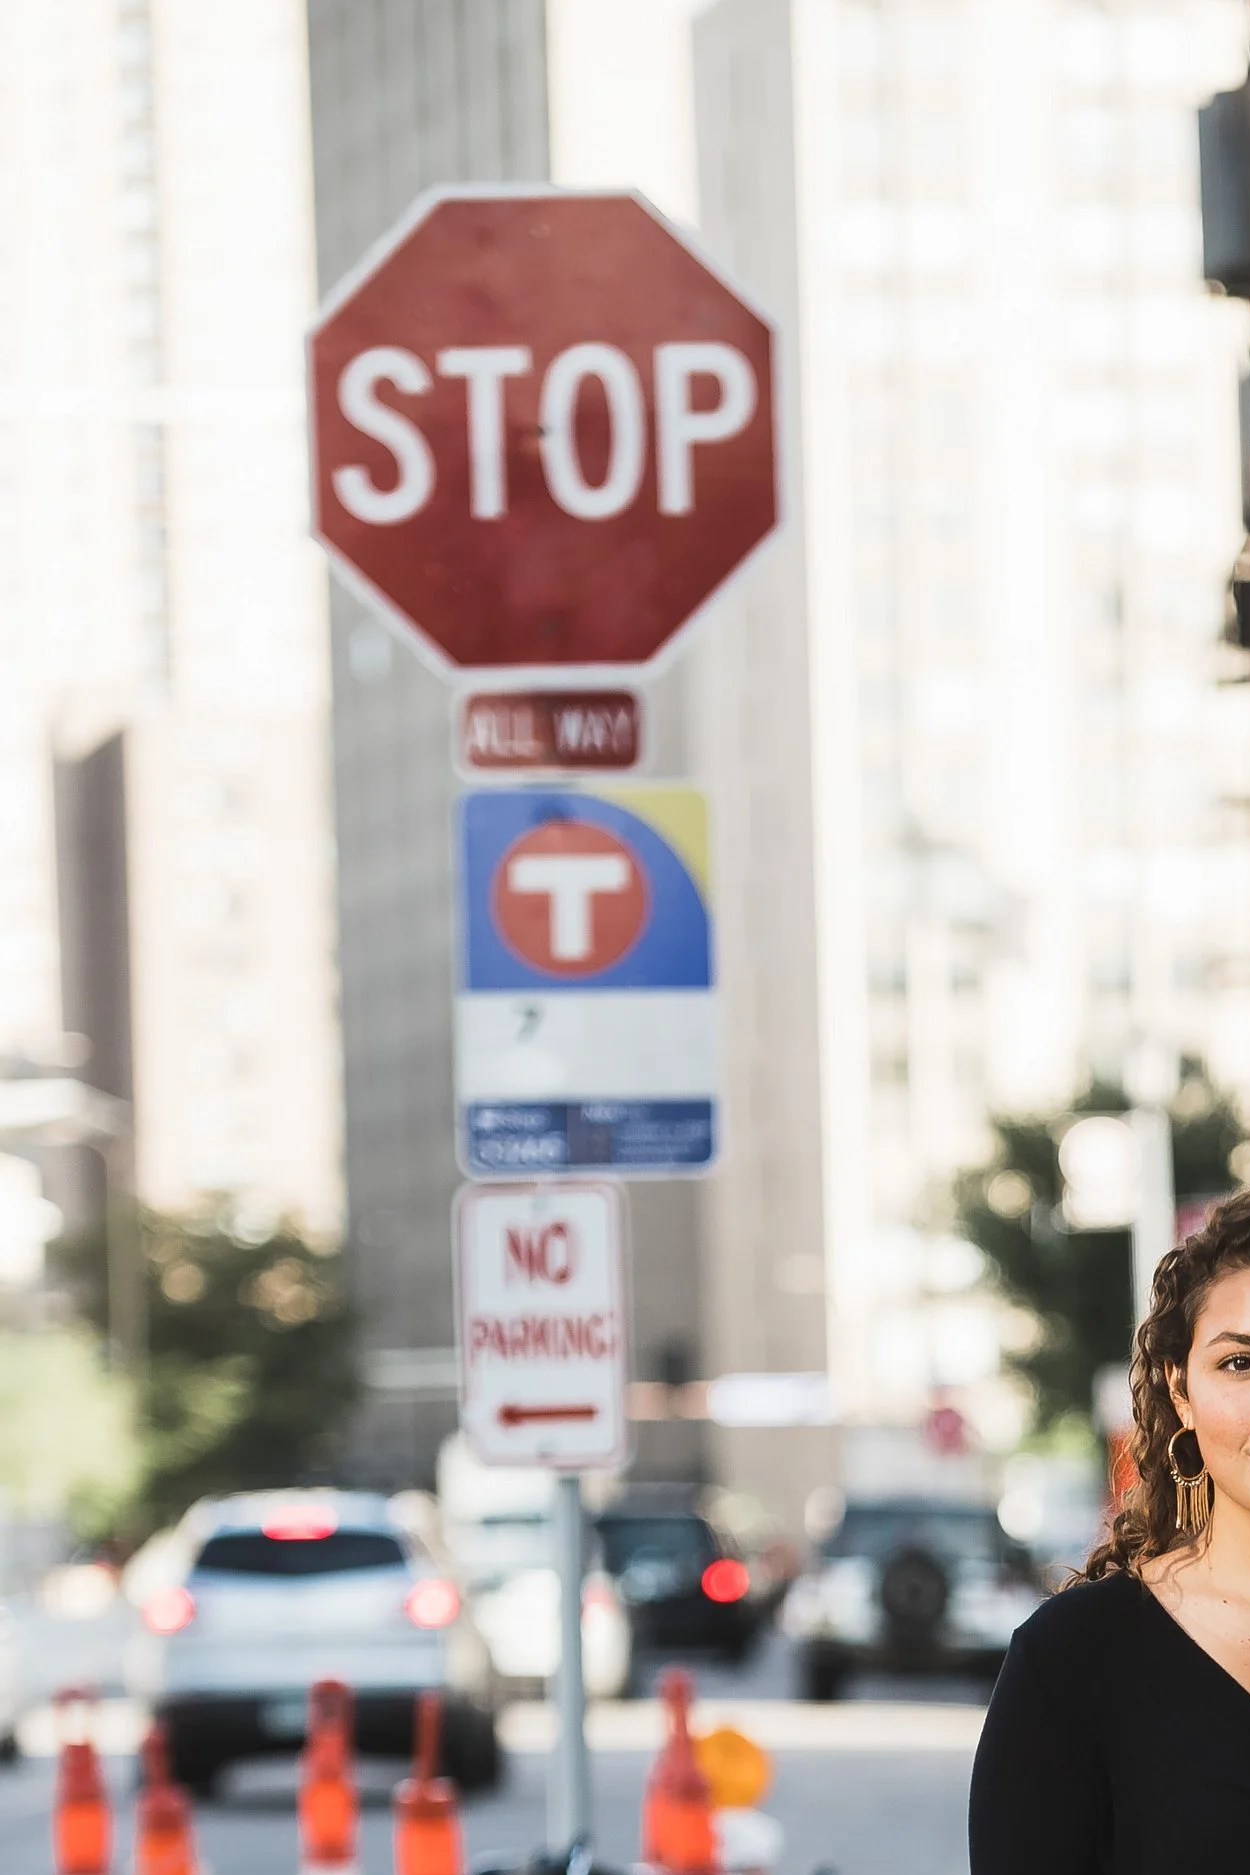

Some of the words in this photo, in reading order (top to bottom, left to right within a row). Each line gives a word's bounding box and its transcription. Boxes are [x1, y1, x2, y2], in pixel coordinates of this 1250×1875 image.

[331, 341, 759, 526] STOP
[508, 855, 632, 960] T
[505, 1222, 576, 1285] NO
[470, 1313, 616, 1364] PARKING
